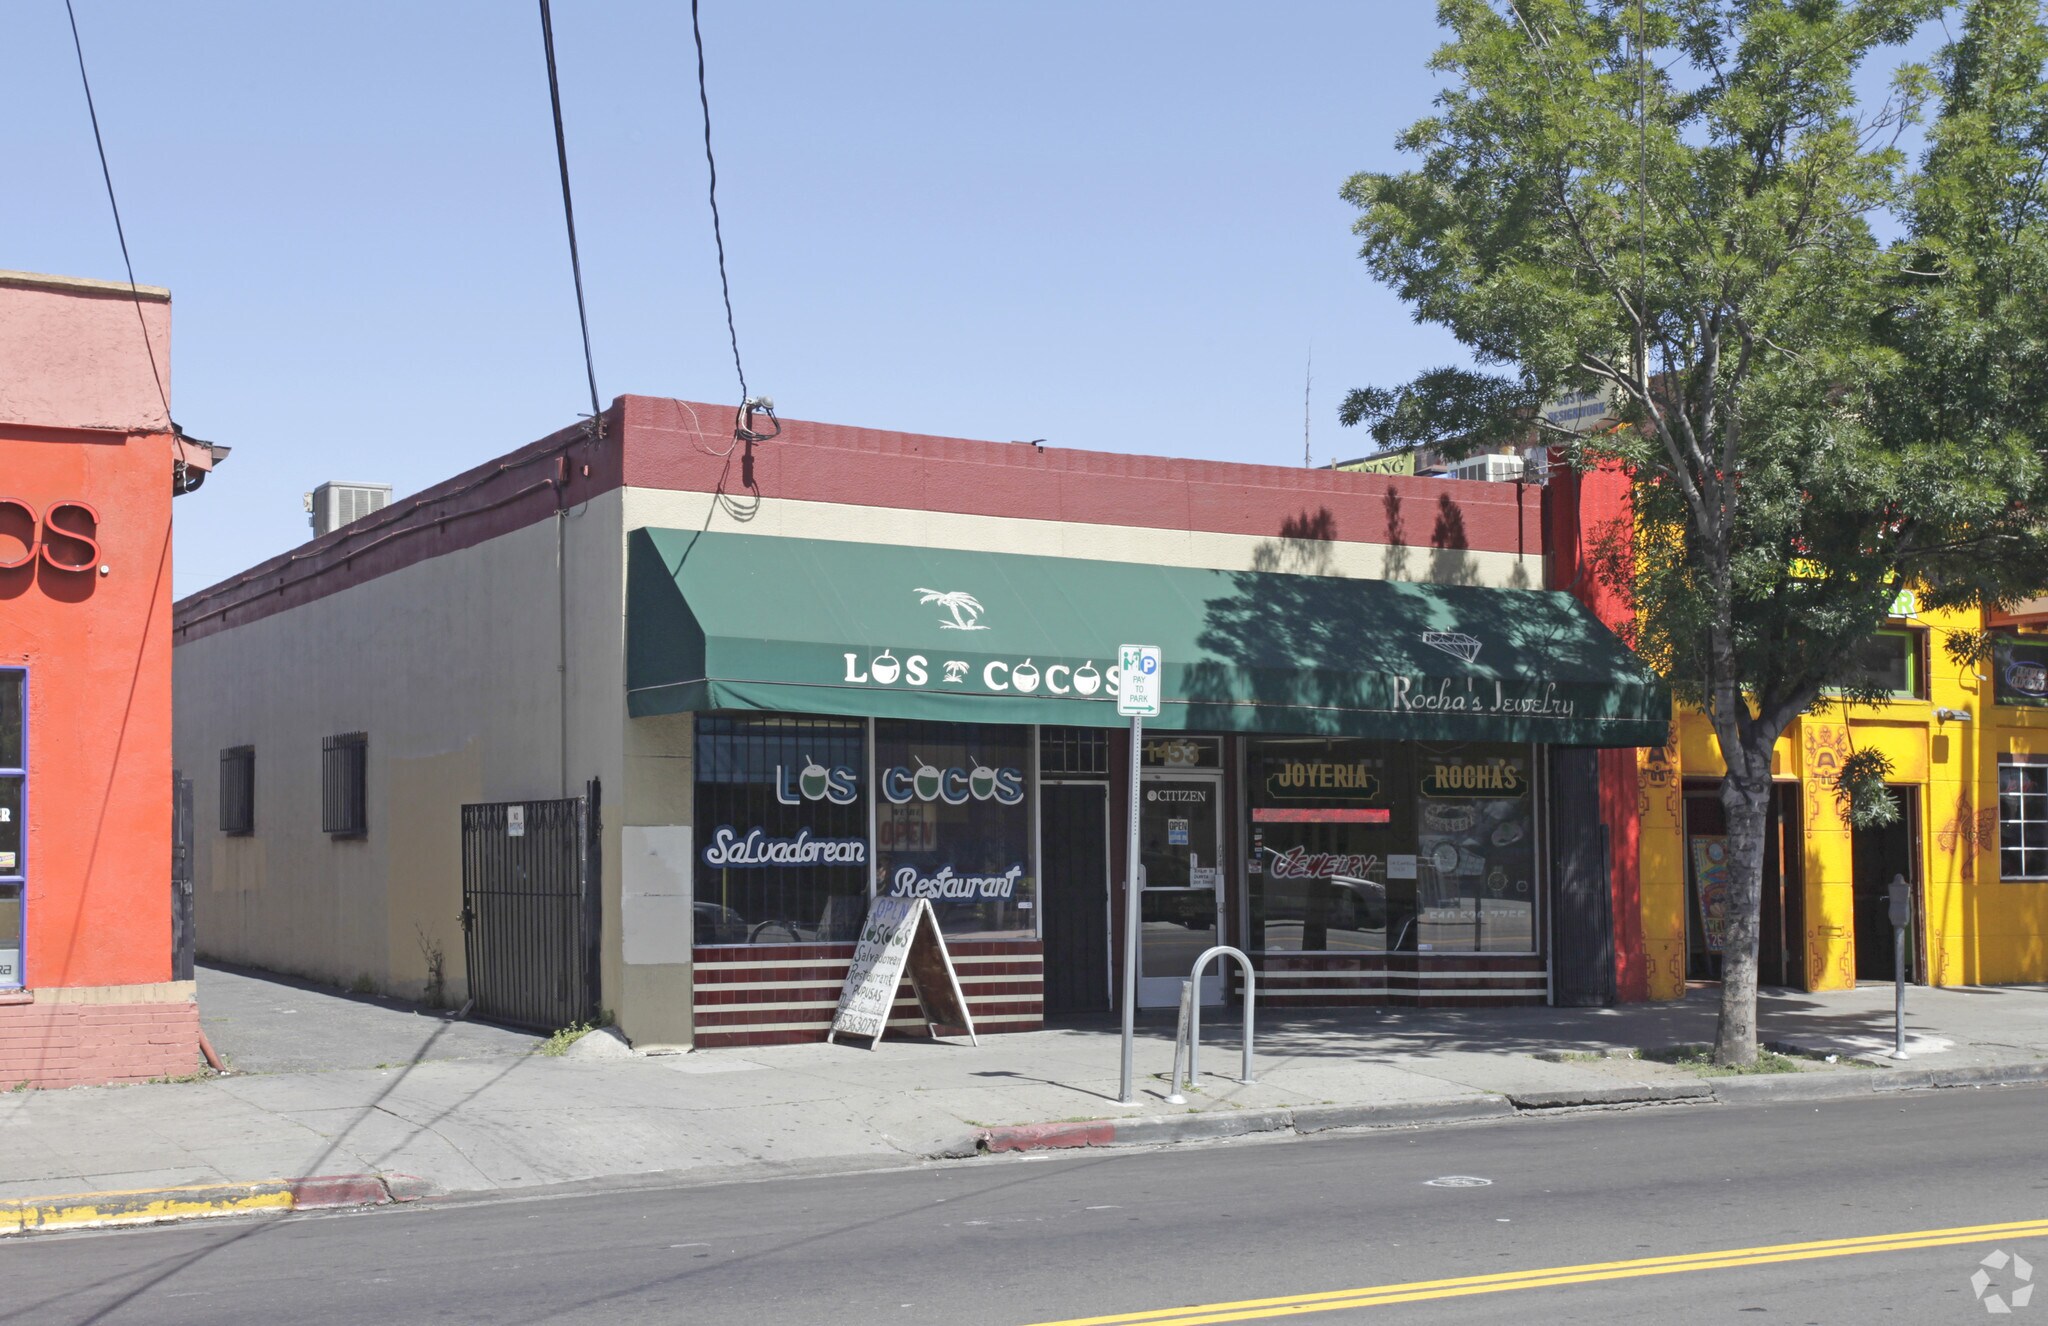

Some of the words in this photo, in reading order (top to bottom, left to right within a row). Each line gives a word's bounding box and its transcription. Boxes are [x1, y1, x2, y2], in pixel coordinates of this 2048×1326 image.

[843, 650, 929, 687] LOS
[982, 658, 1120, 696] COCOS
[1132, 675, 1146, 684] PAY
[1129, 694, 1148, 703] PARK
[1135, 685, 1144, 693] TO
[1392, 675, 1483, 711] Rocha's
[1489, 680, 1575, 717] Jewelry
[1146, 741, 1200, 764] 1453
[776, 757, 858, 806] LOS
[882, 757, 1024, 806] COCOS
[1278, 763, 1368, 788] JOYERIA
[1435, 759, 1518, 790] ROCHA'S
[1157, 789, 1206, 802] CITIZEN
[880, 820, 934, 846] OPEN
[1169, 820, 1188, 831] OPEN
[890, 864, 1023, 901] Restaurant
[876, 899, 910, 921] OPEN
[852, 984, 884, 1002] PUPUSAS
